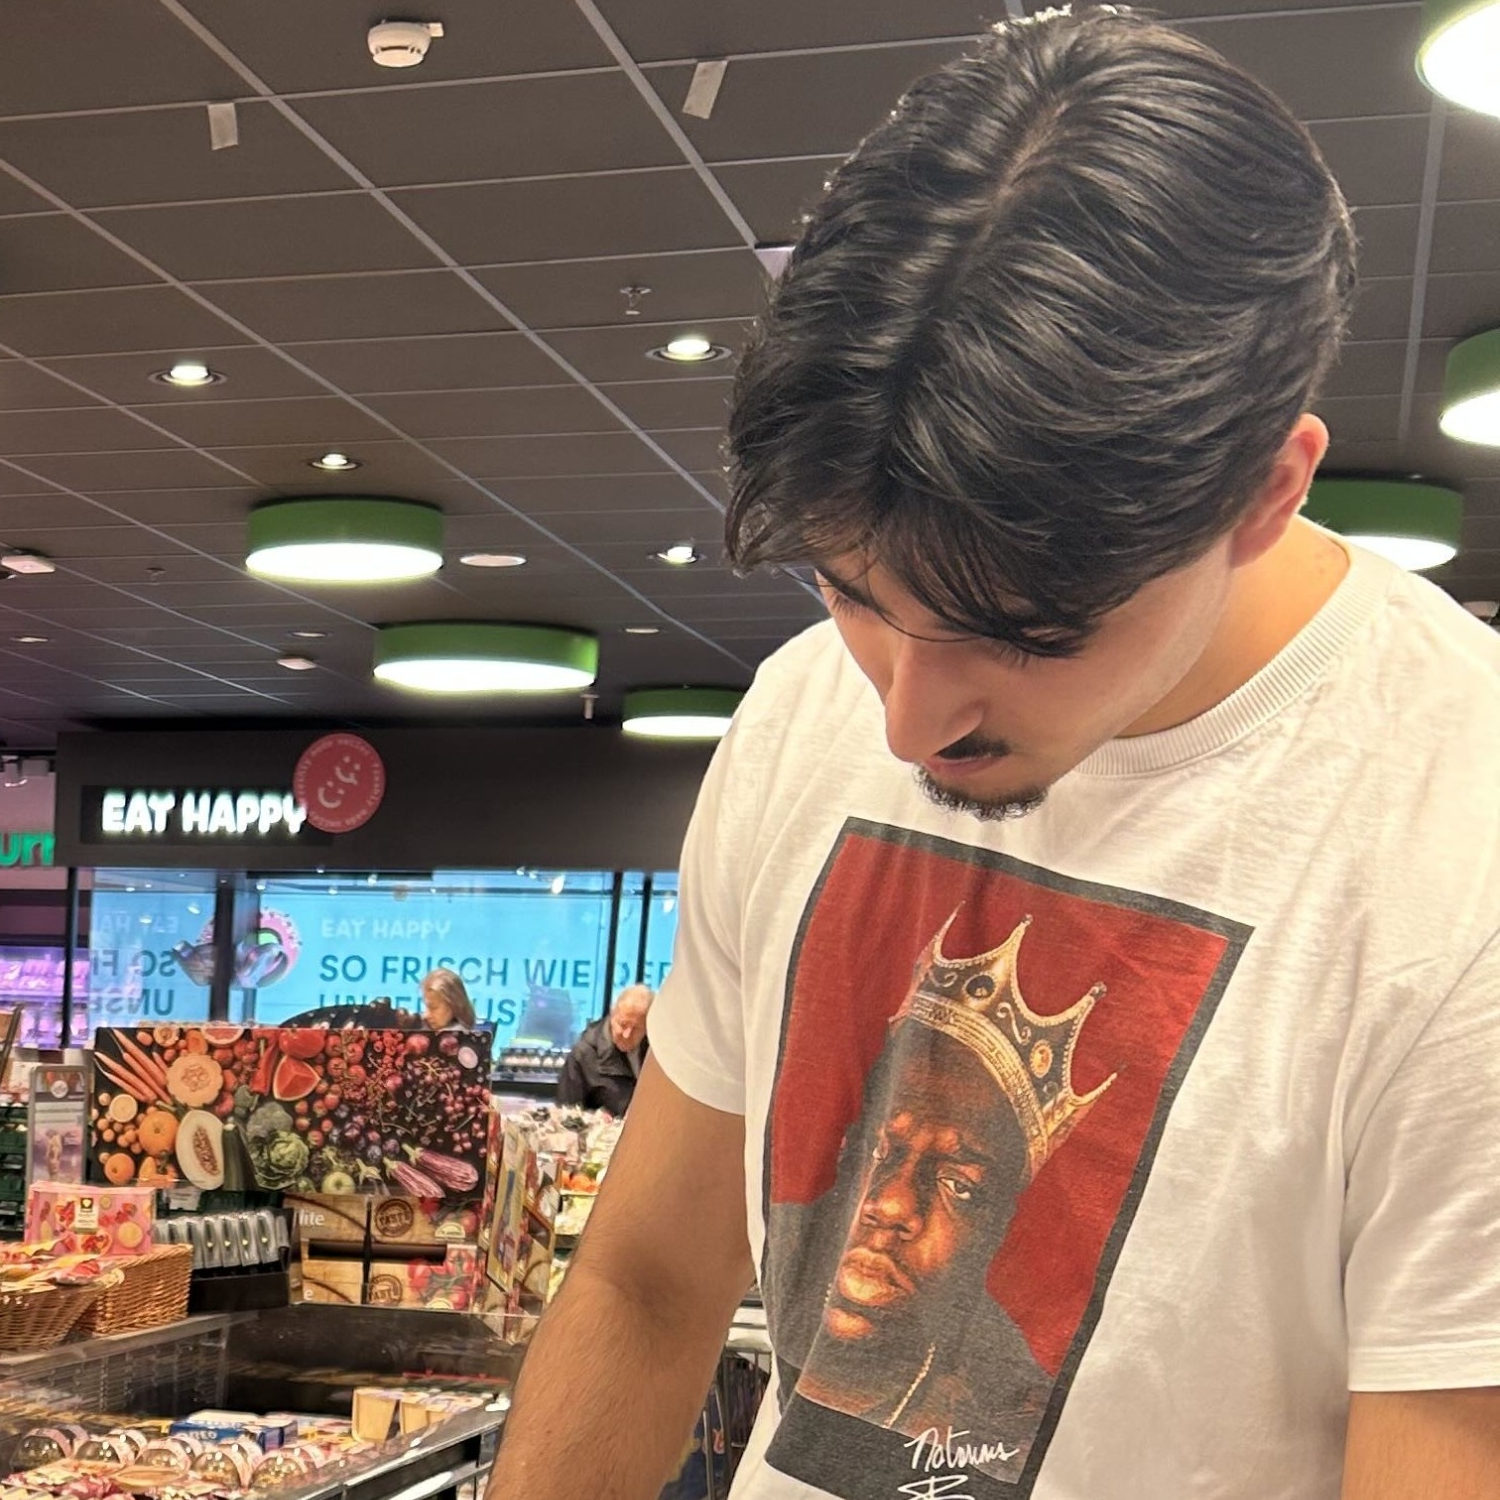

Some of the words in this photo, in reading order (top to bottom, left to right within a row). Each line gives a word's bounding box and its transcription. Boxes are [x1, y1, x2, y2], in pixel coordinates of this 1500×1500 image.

[102, 793, 175, 832] EAT
[181, 794, 306, 834] HAPPY
[321, 919, 366, 939] EAT
[372, 919, 452, 940] HAPPY
[319, 954, 367, 982] SO
[524, 958, 592, 987] WIE
